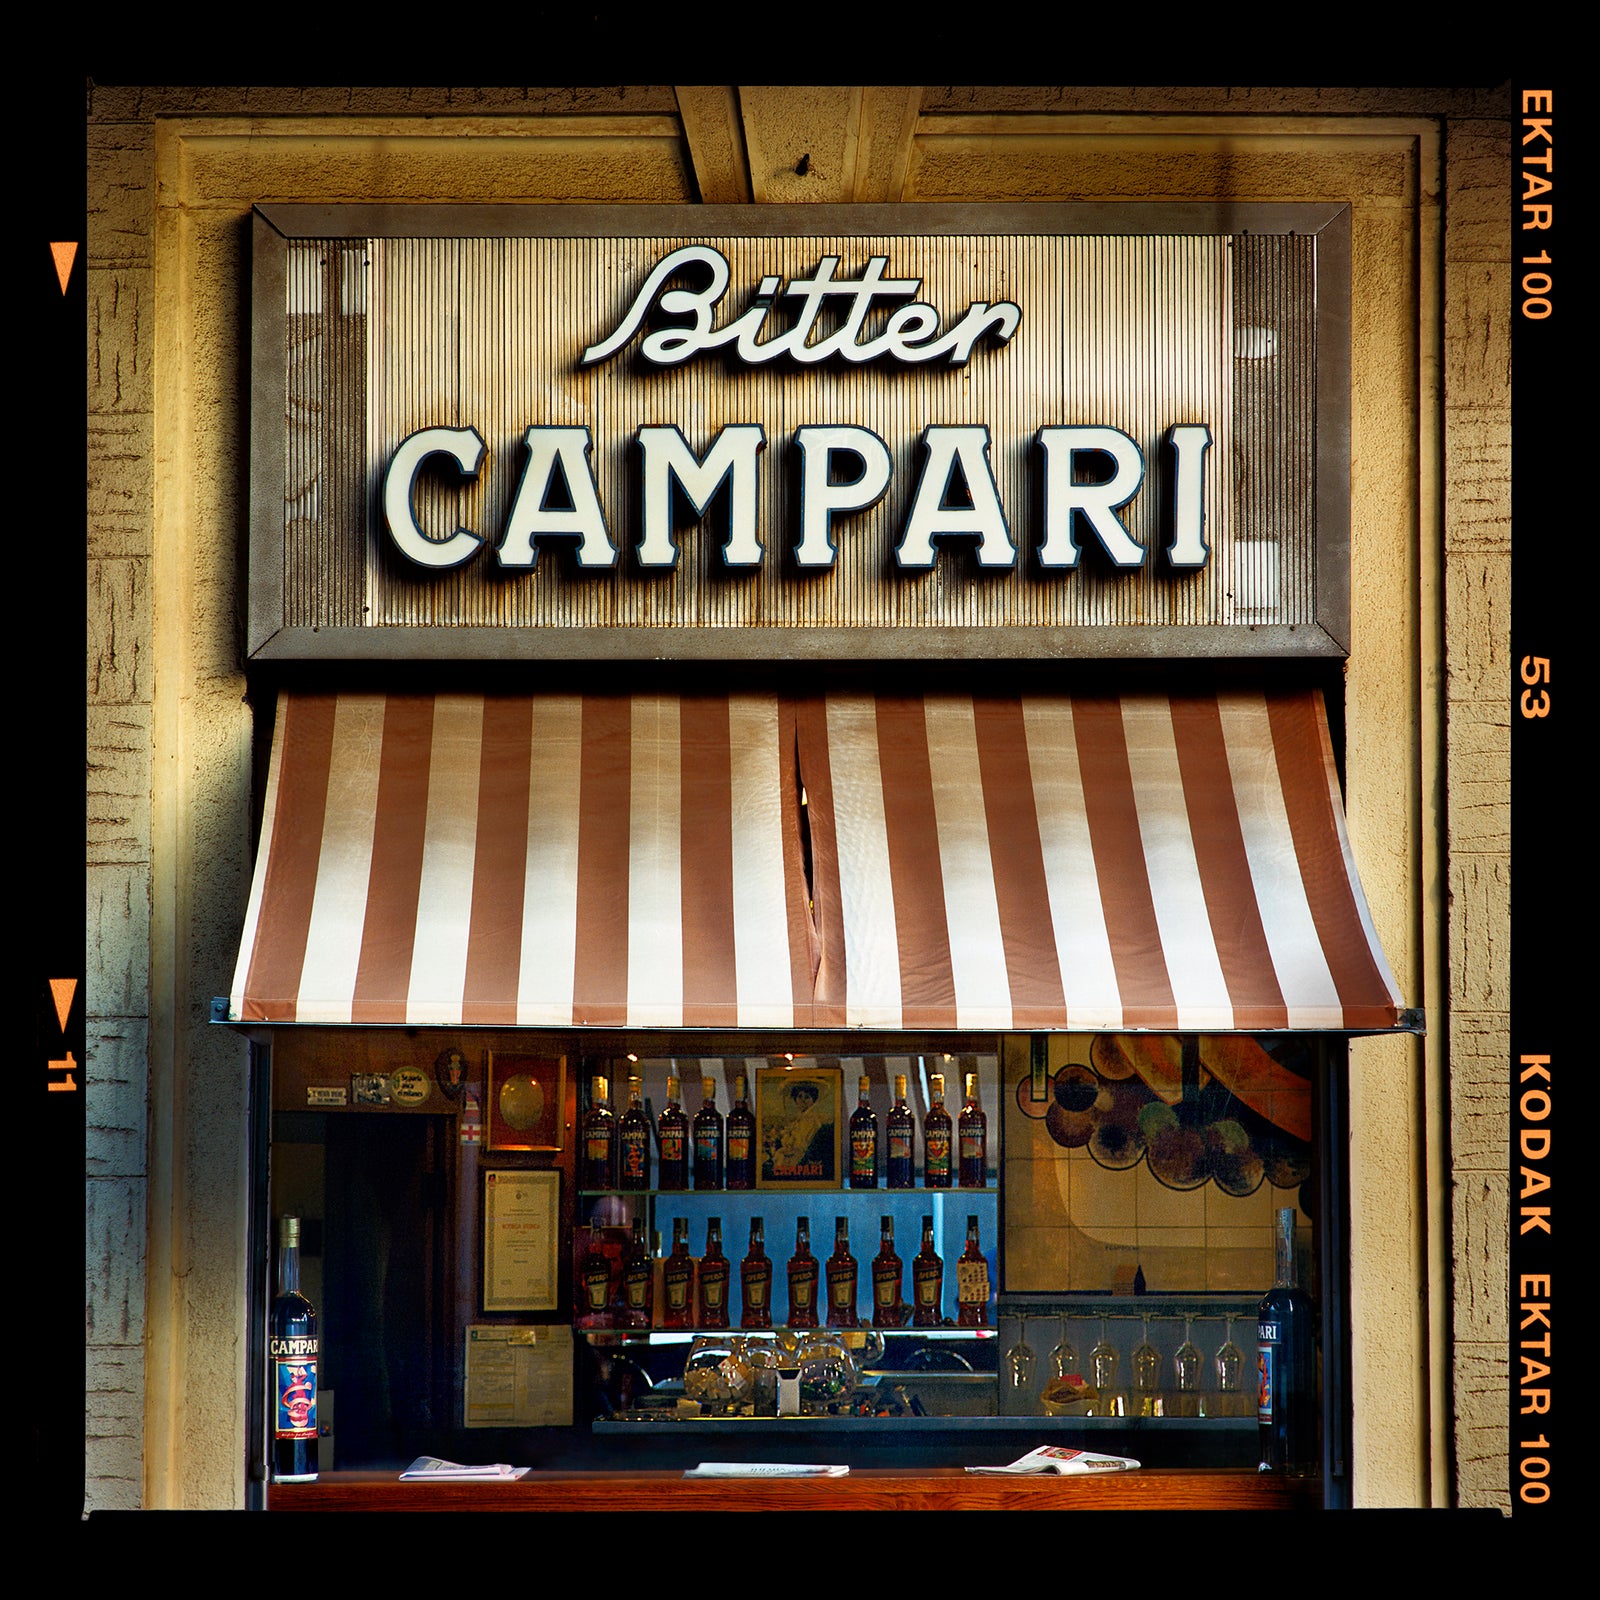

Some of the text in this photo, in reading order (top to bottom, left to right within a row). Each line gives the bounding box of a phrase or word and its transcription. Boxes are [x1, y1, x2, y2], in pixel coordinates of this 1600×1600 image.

[582, 244, 1021, 365] Bitter
[383, 424, 1212, 569] CAMPARI
[270, 1339, 318, 1354] CAMPAR
